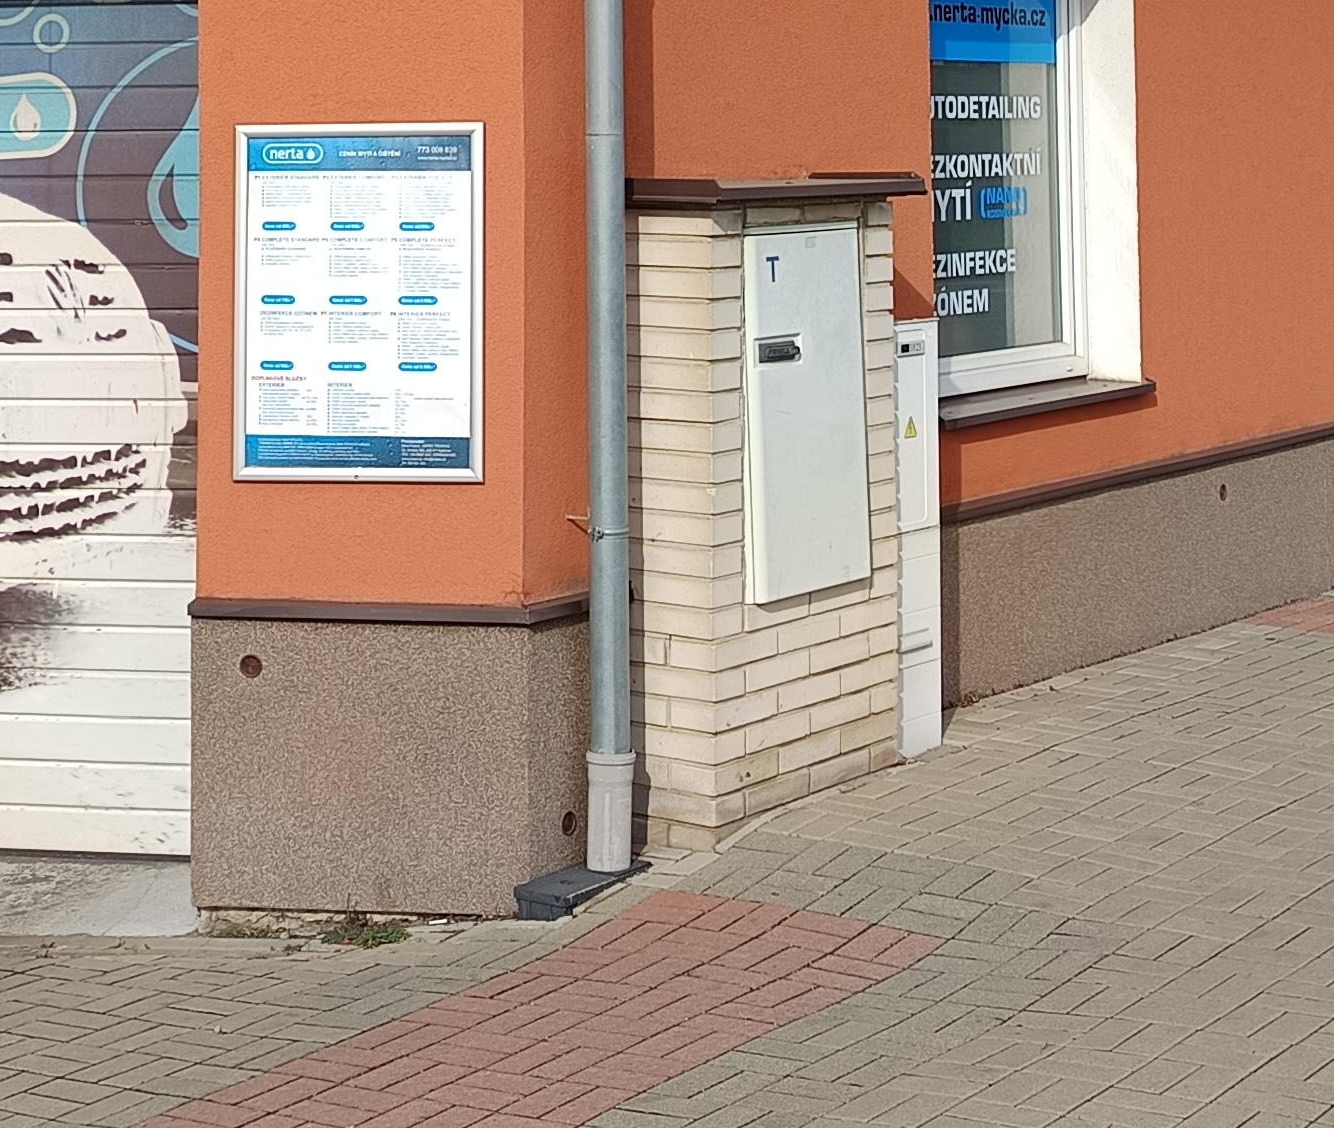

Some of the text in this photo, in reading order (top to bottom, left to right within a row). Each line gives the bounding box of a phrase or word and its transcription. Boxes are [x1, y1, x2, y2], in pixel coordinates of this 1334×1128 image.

[269, 146, 304, 160] nerta
[932, 147, 1041, 180] ZKONTAKTNÍ
[932, 179, 972, 222] YTÍ
[764, 256, 780, 283] T
[933, 249, 1016, 279] ZINFEKCE
